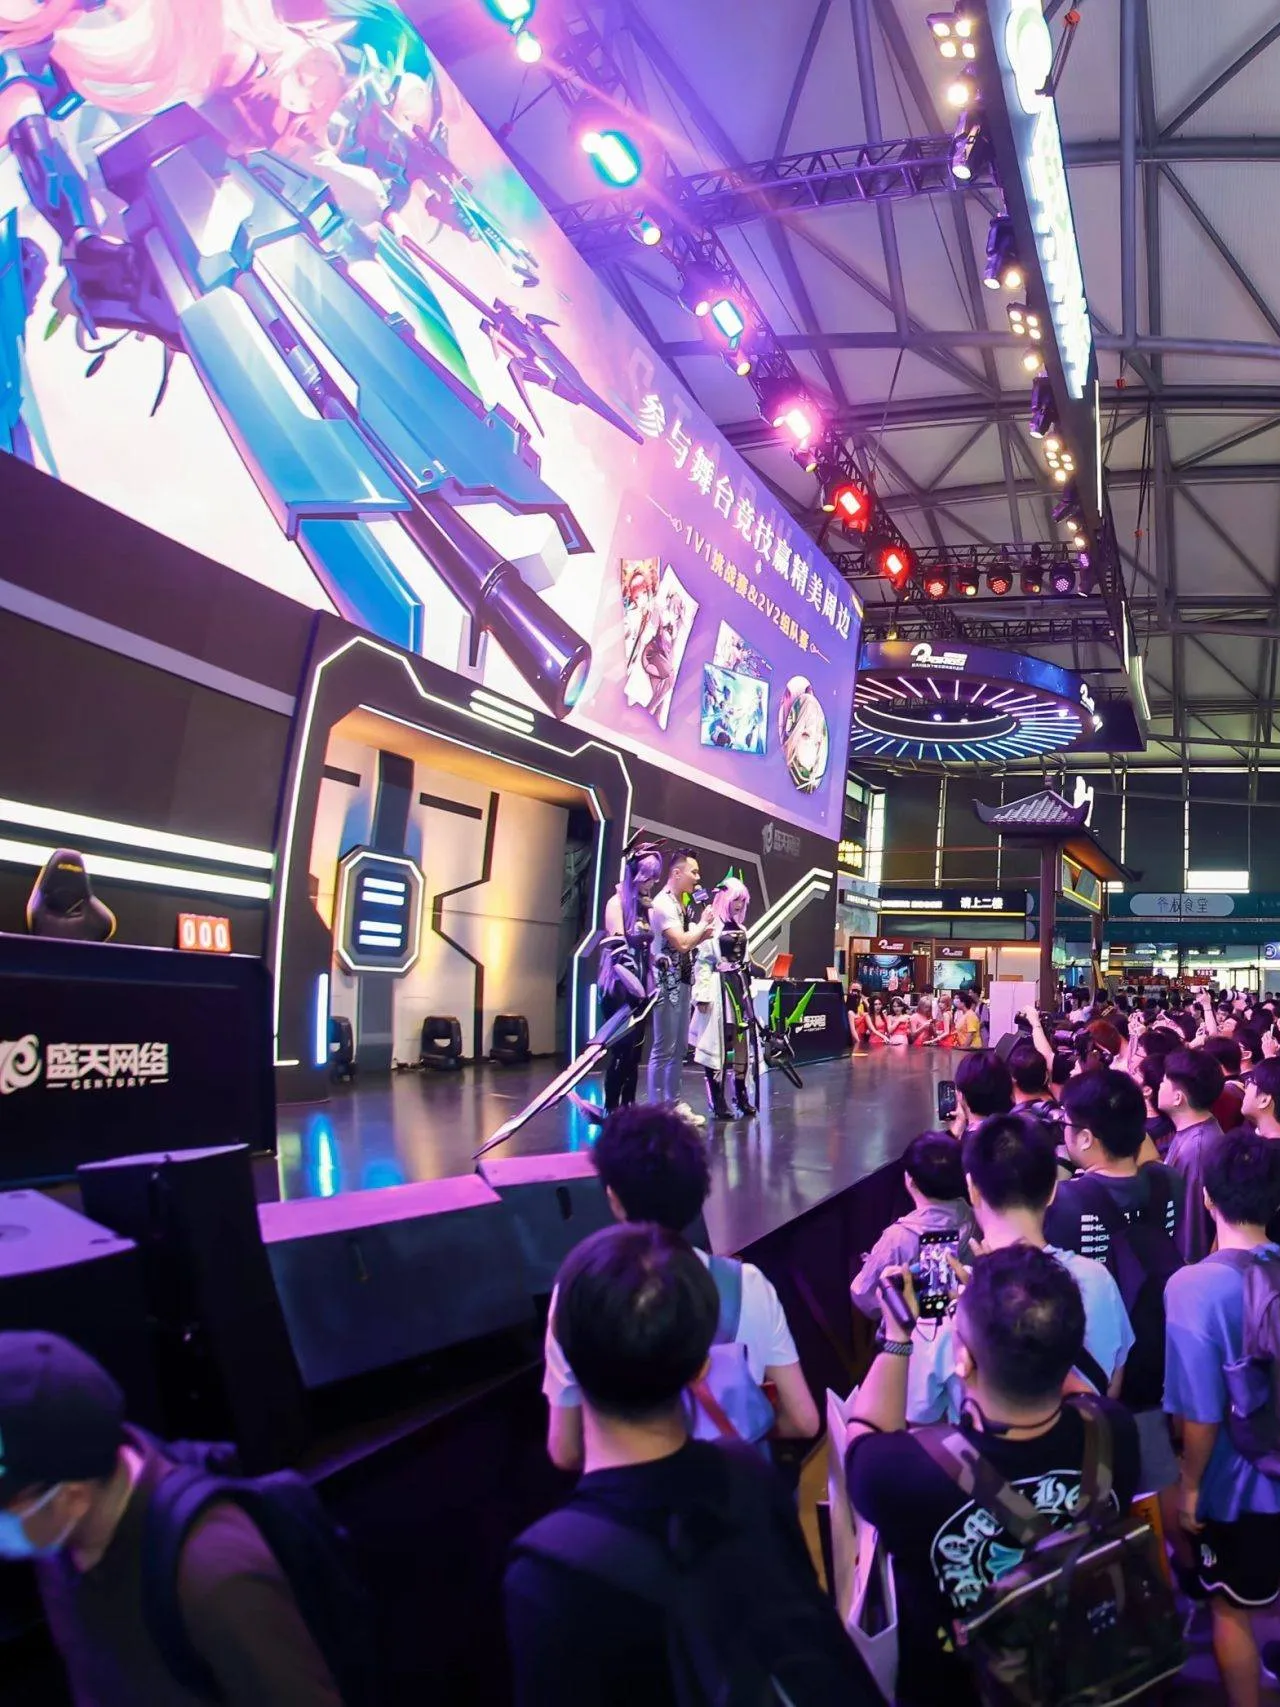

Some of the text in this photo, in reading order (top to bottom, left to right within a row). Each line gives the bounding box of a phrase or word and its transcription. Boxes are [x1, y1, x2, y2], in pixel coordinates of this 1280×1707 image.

[635, 394, 852, 640] 参与舞台竞技赢精美周边
[46, 1042, 168, 1079] 盛天网络
[71, 1078, 147, 1090] CENTURY
